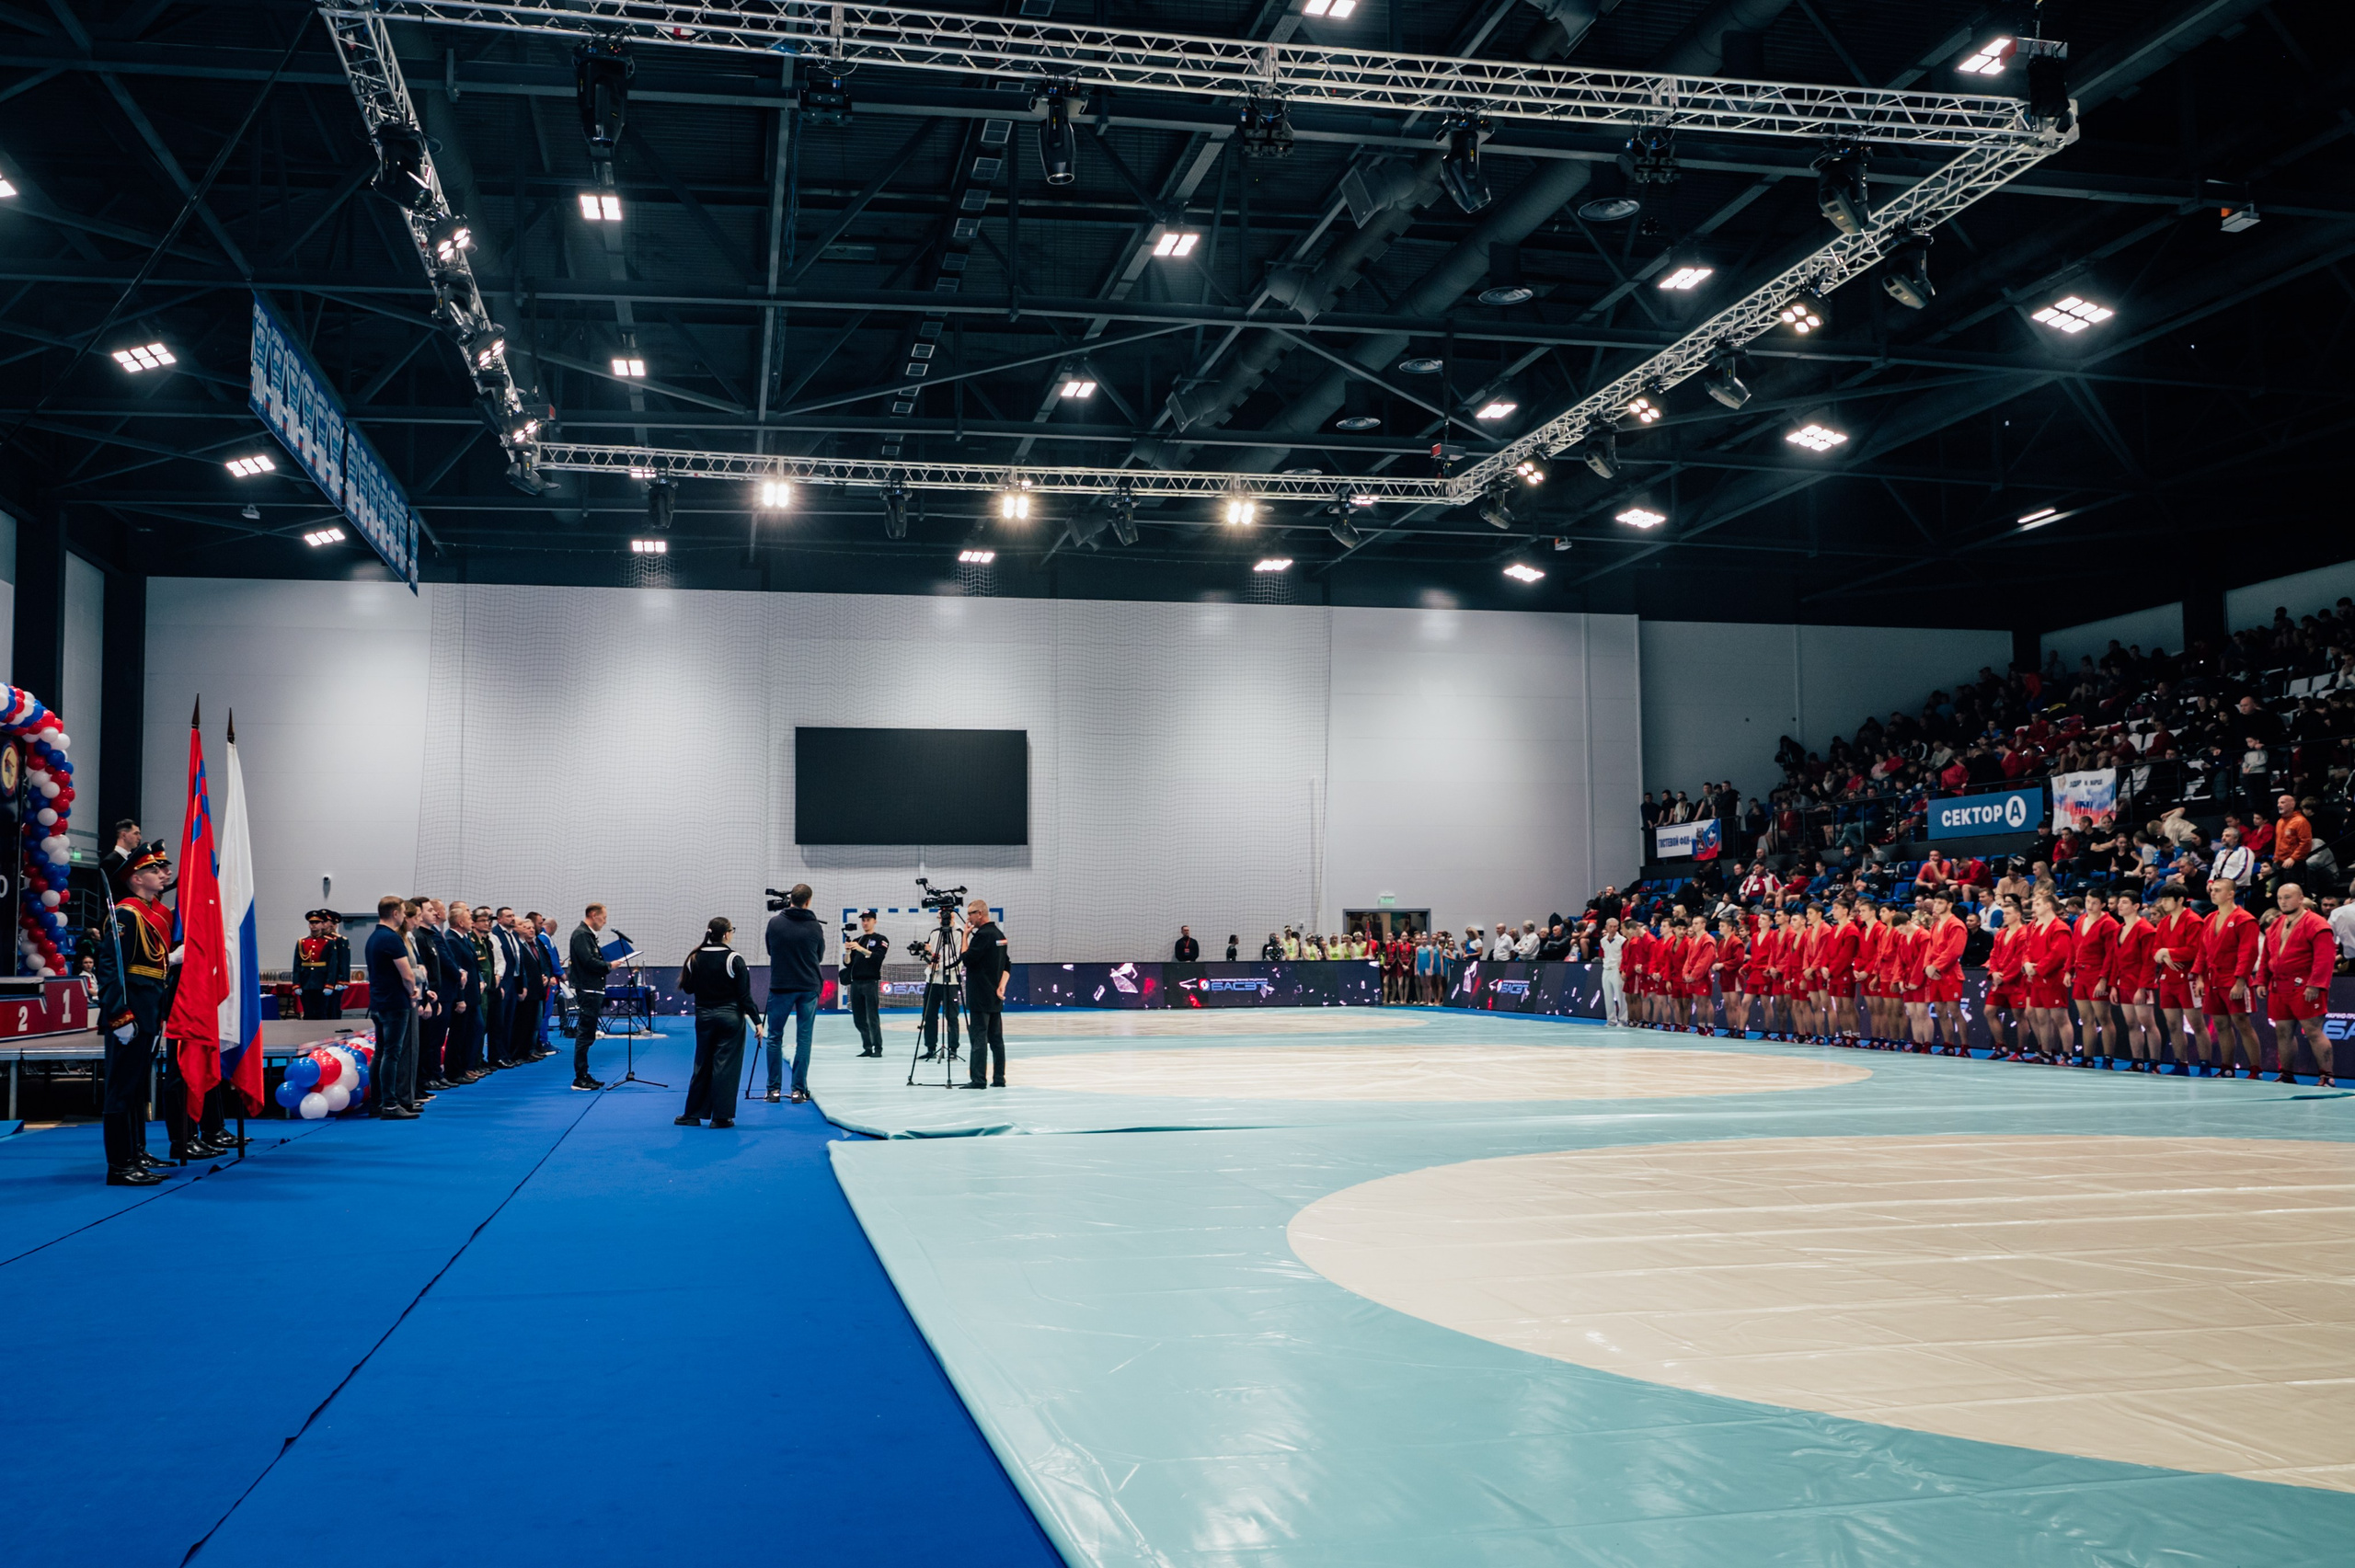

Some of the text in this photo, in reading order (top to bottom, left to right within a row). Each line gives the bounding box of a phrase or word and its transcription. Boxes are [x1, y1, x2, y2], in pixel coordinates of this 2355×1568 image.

[1941, 805, 2003, 827] СЕКТОР
[1211, 981, 1269, 990] БАСЭТ
[17, 1005, 29, 1032] 2
[62, 989, 72, 1024] 1
